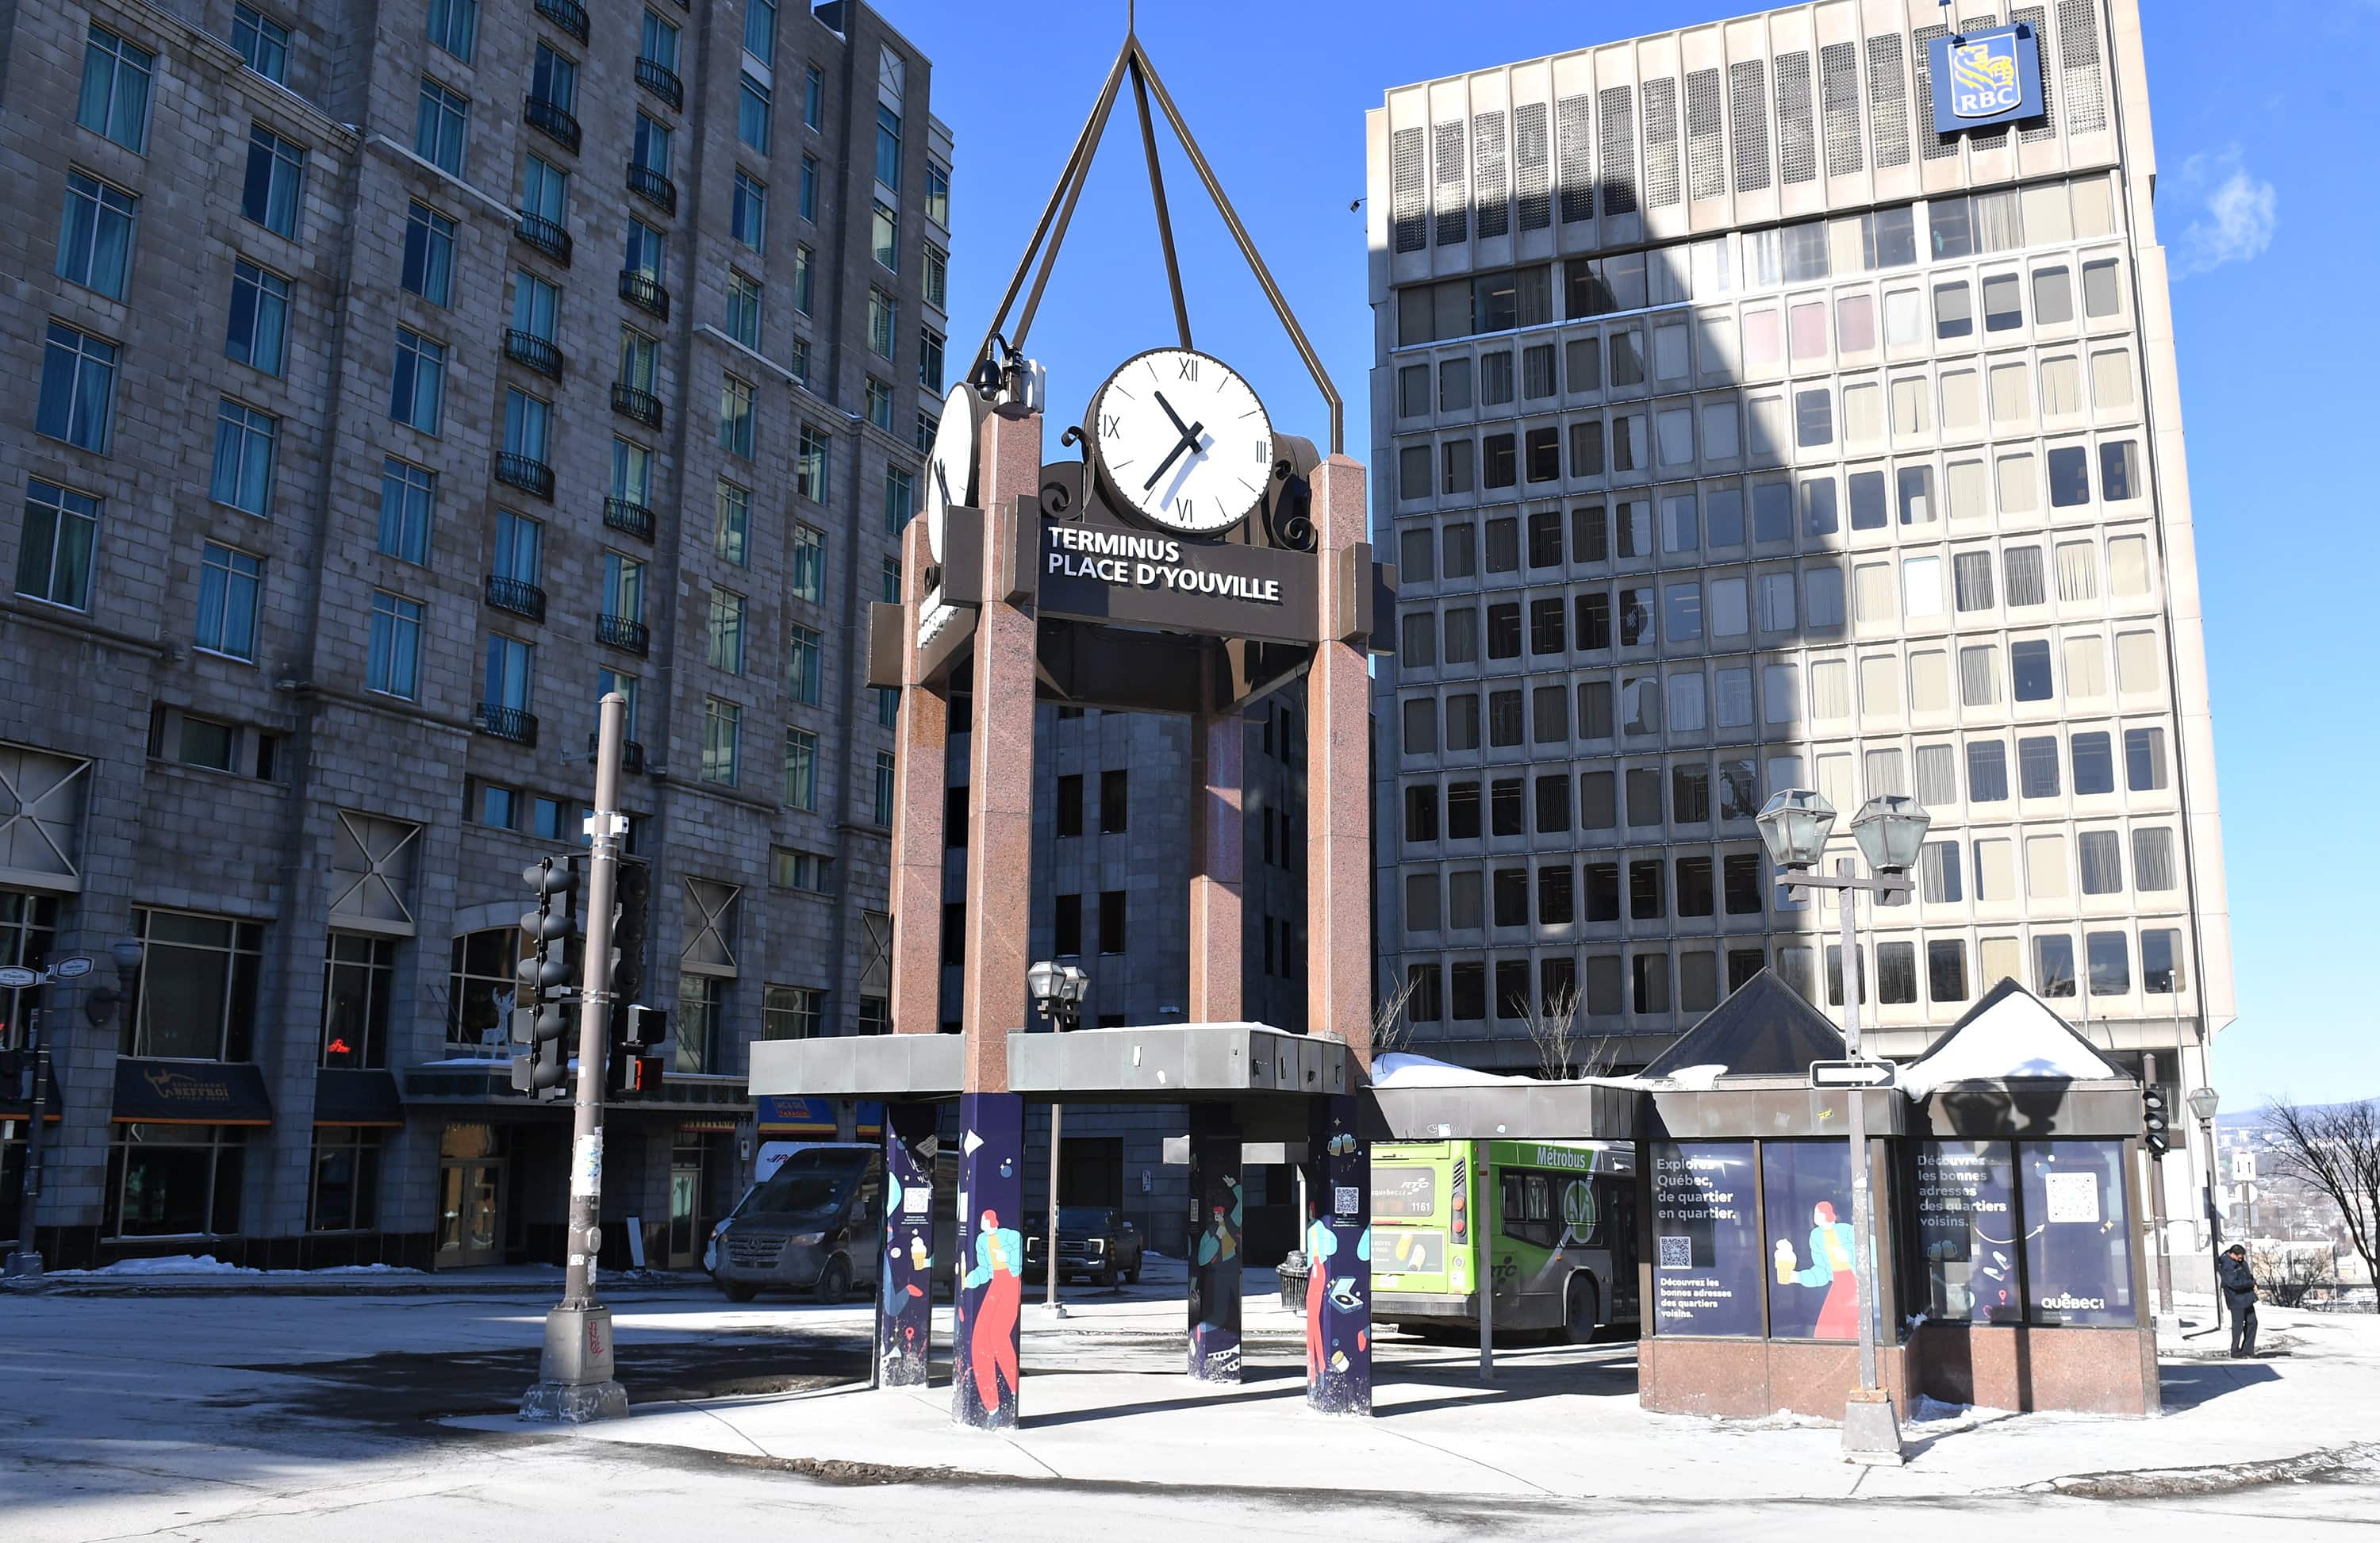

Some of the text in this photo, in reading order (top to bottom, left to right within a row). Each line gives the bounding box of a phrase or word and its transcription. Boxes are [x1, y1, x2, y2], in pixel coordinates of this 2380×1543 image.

[1960, 87, 2013, 112] RBC
[1179, 357, 1198, 382] XII
[1104, 414, 1120, 439] IX
[1256, 440, 1266, 463] III
[1176, 497, 1192, 523] VI
[1048, 526, 1180, 562] TERMINUS
[1048, 553, 1280, 601] PLACE D'YOUVILLE
[1537, 1146, 1586, 1169] Métrobus
[1917, 1154, 1987, 1165] Découvrez
[1657, 1174, 1714, 1188] Québec,
[1918, 1169, 1987, 1180] les bonnes
[1658, 1190, 1733, 1205] de quartier
[1919, 1185, 1977, 1196] adresses
[1411, 1202, 1430, 1211] 1161
[1920, 1198, 2007, 1214] des quartiers
[1658, 1206, 1737, 1222] en quartier.
[1920, 1215, 1968, 1226] voisins.
[1660, 1288, 1733, 1297] bonnes adresses
[1660, 1299, 1718, 1309] des quartiers
[1660, 1309, 1694, 1318] voisins.
